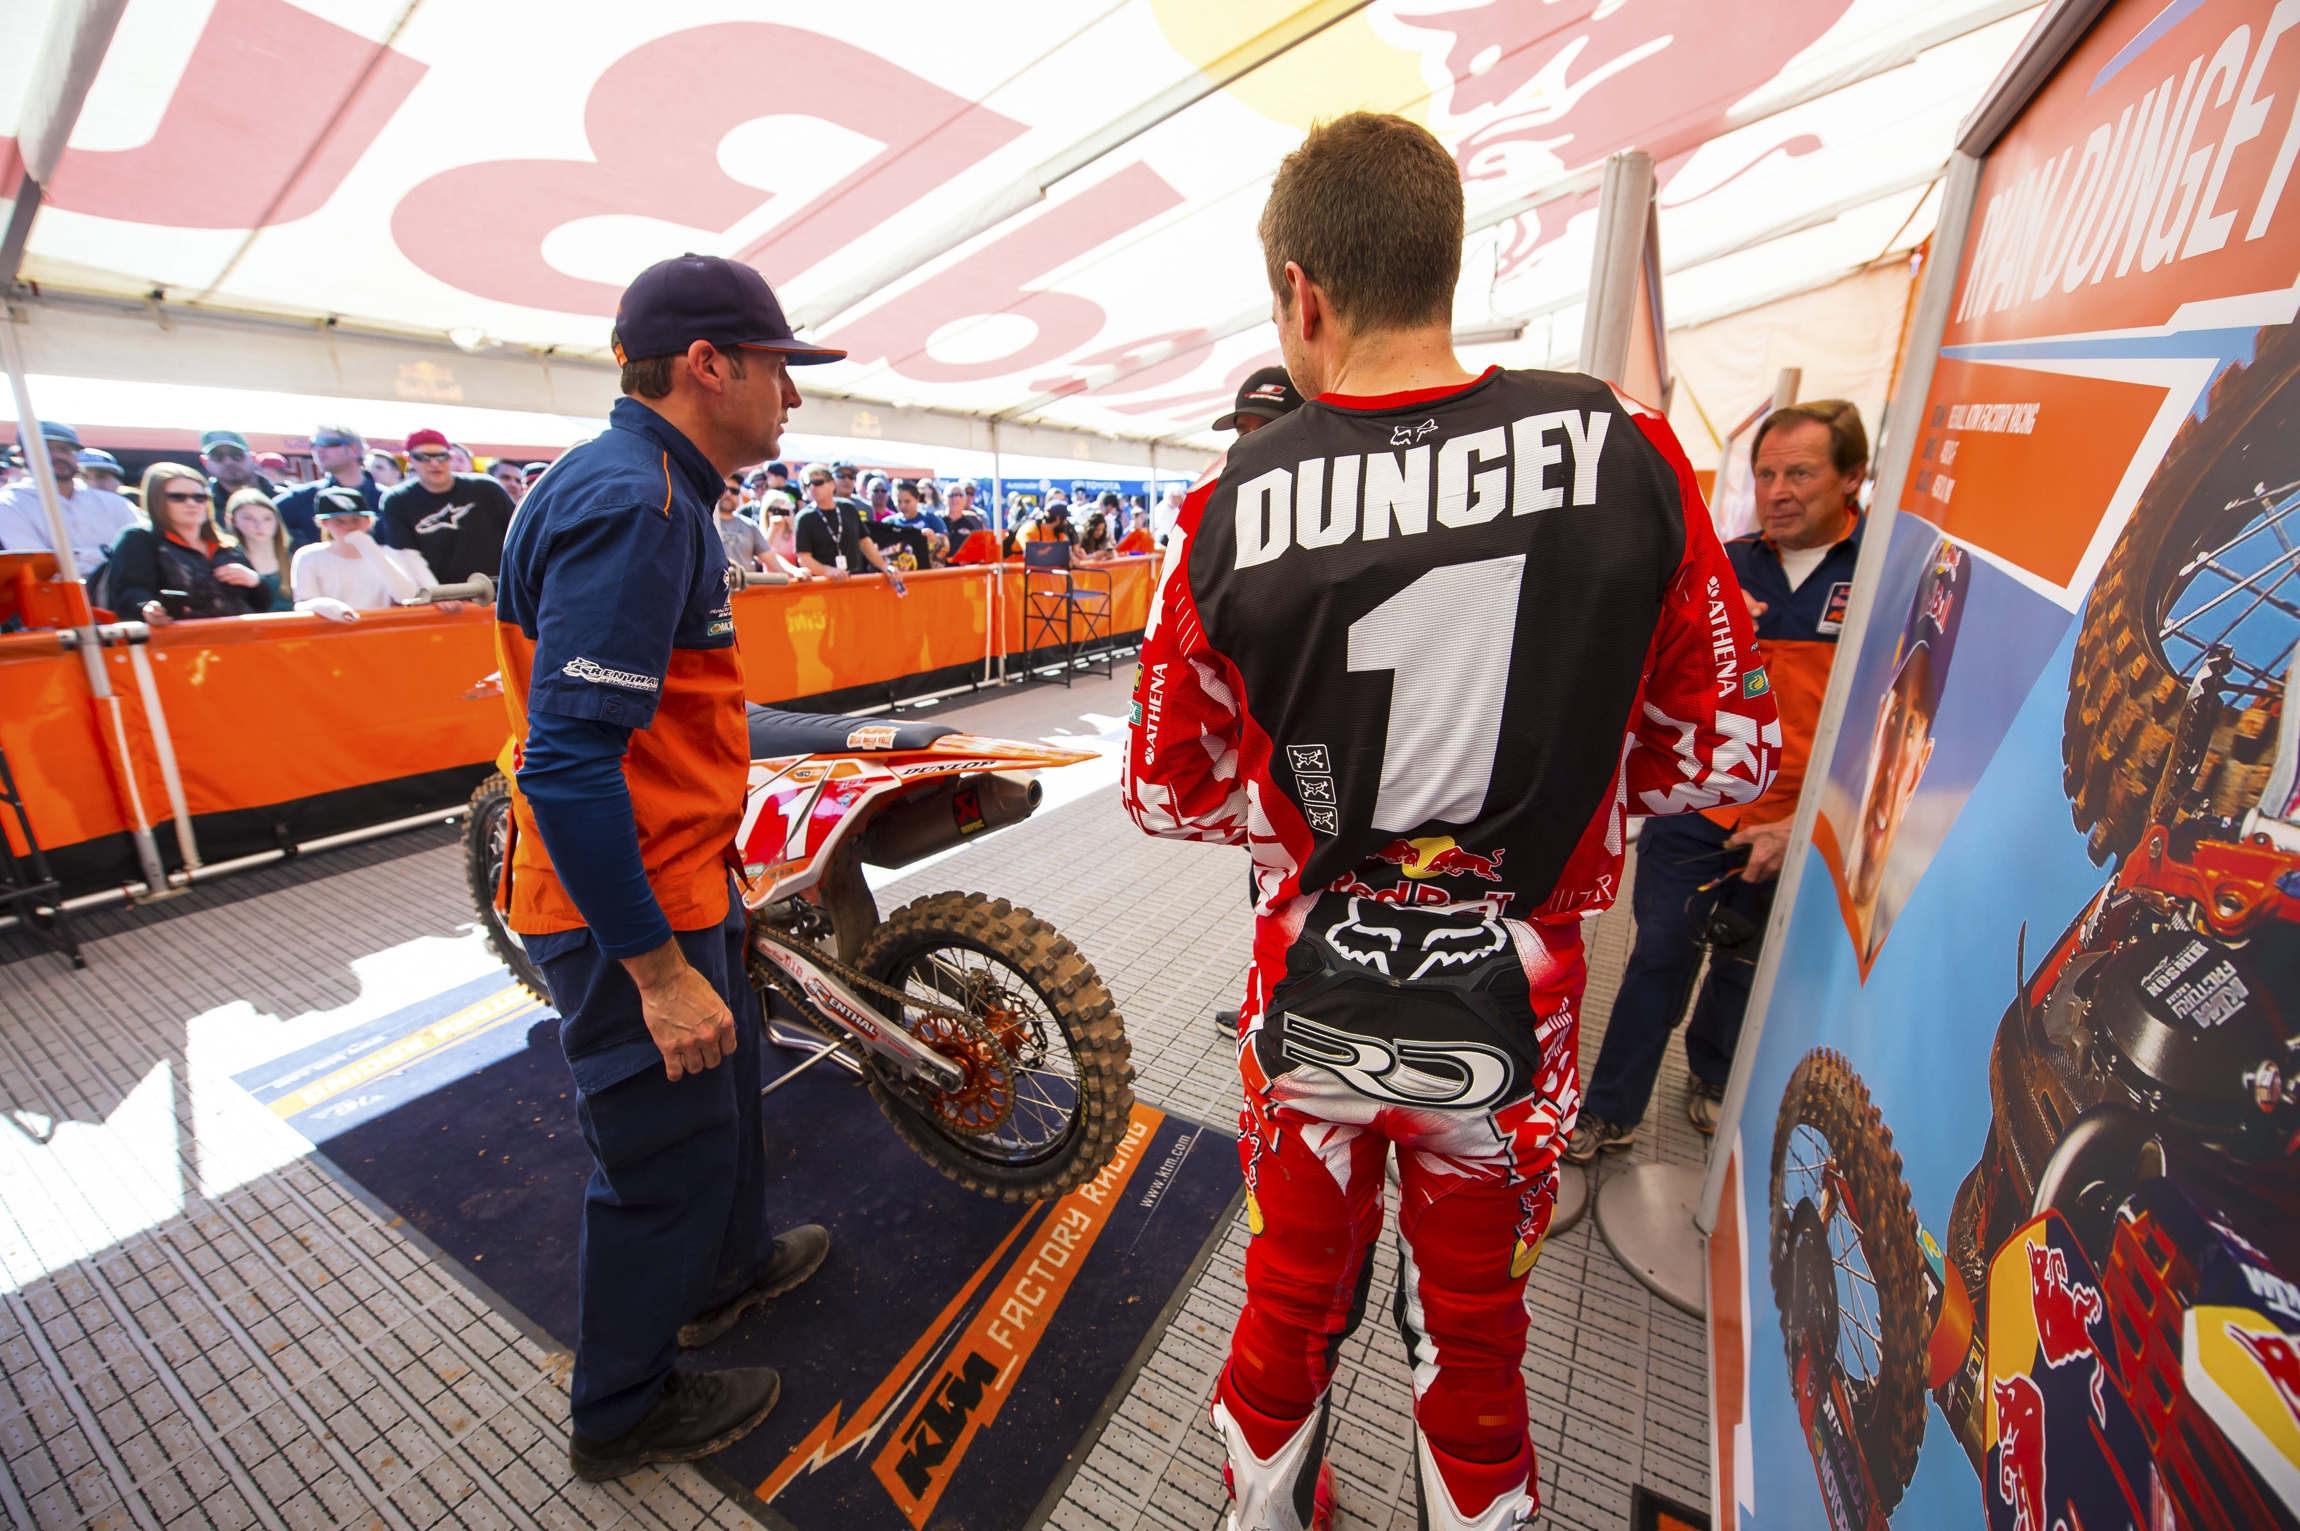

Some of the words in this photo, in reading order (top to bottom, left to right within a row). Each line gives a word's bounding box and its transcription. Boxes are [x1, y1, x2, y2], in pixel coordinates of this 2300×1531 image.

[1955, 144, 2074, 324] RYAN
[1085, 481, 1121, 491] TOYOTA
[1234, 409, 1612, 570] DUNGEY
[1708, 599, 1738, 699] ATHENA
[1146, 663, 1169, 749] ATHENA
[1346, 553, 1527, 832] 1
[901, 759, 996, 776] DUNLOP
[777, 785, 816, 862] 1
[2146, 940, 2210, 998] HINSON
[2170, 959, 2238, 1020] FACTORY
[2191, 976, 2250, 1029] KTM
[299, 1037, 428, 1105] RACING
[1139, 1133, 1192, 1209] www.ktm.com
[894, 1350, 1000, 1502] KTM
[986, 1207, 1092, 1350] FACTORY
